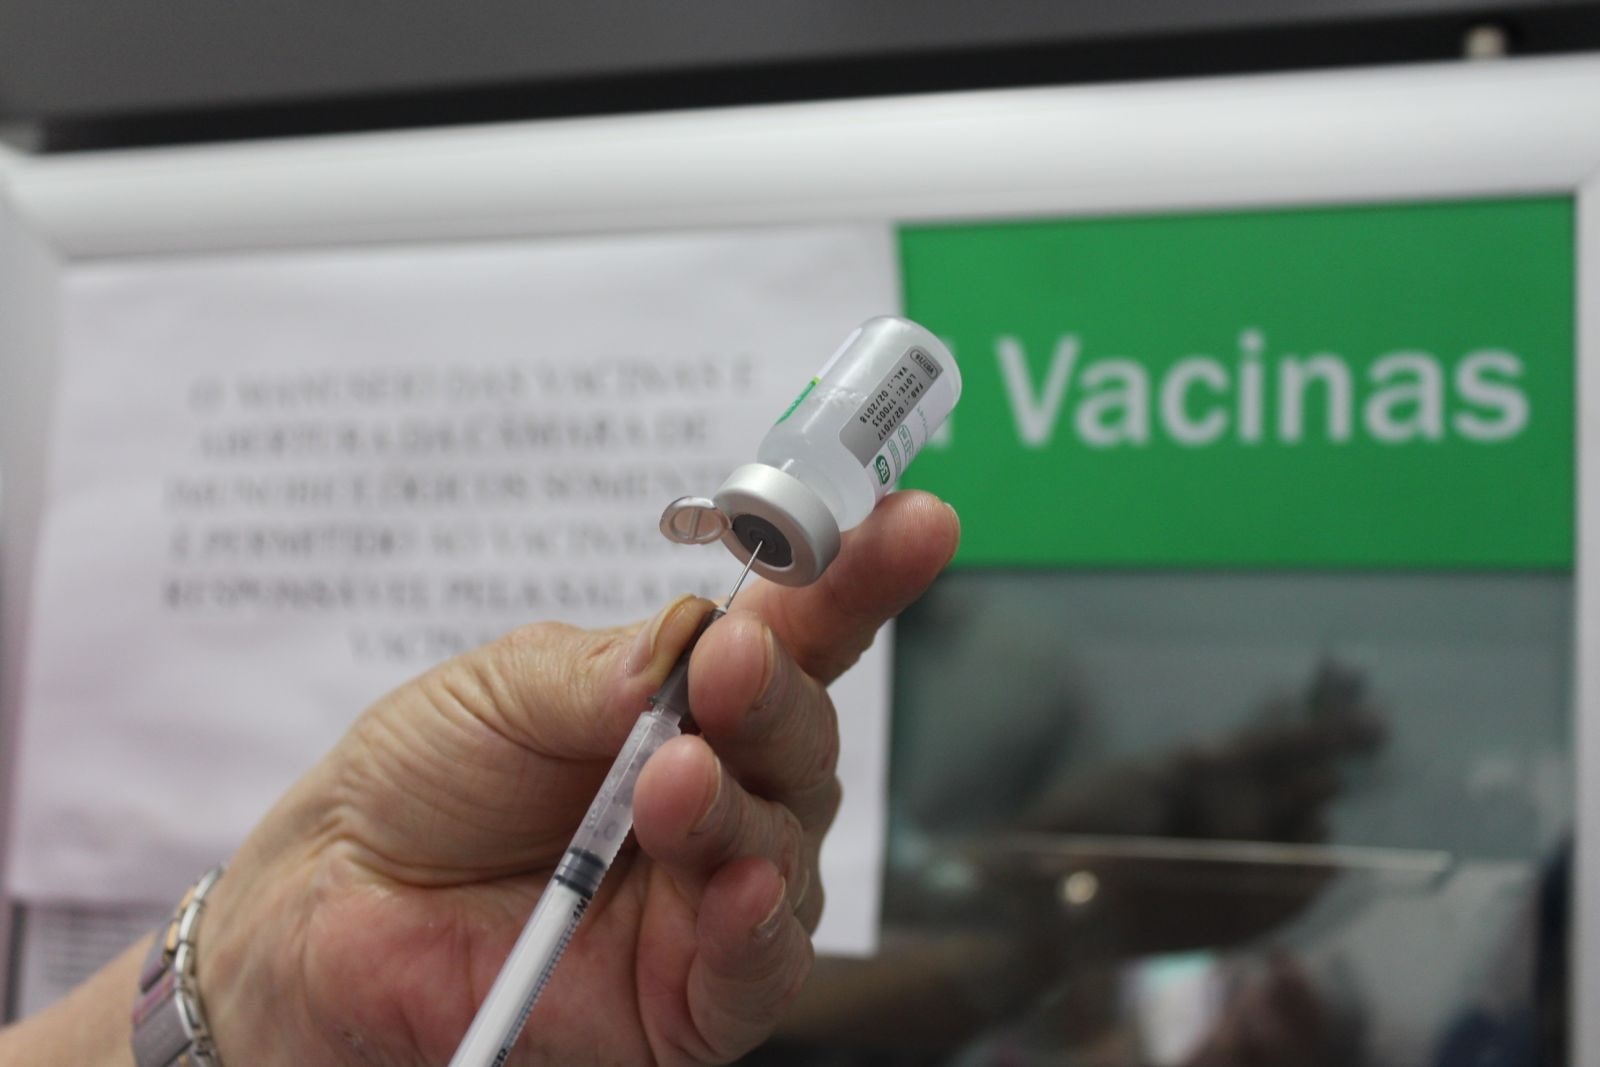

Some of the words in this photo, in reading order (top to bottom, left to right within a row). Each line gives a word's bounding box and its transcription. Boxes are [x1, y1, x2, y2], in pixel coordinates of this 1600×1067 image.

[896, 373, 917, 397] LOTE:
[996, 329, 1530, 448] Vacinas
[859, 390, 889, 424] 02/2018
[878, 407, 904, 441] 02/2017
